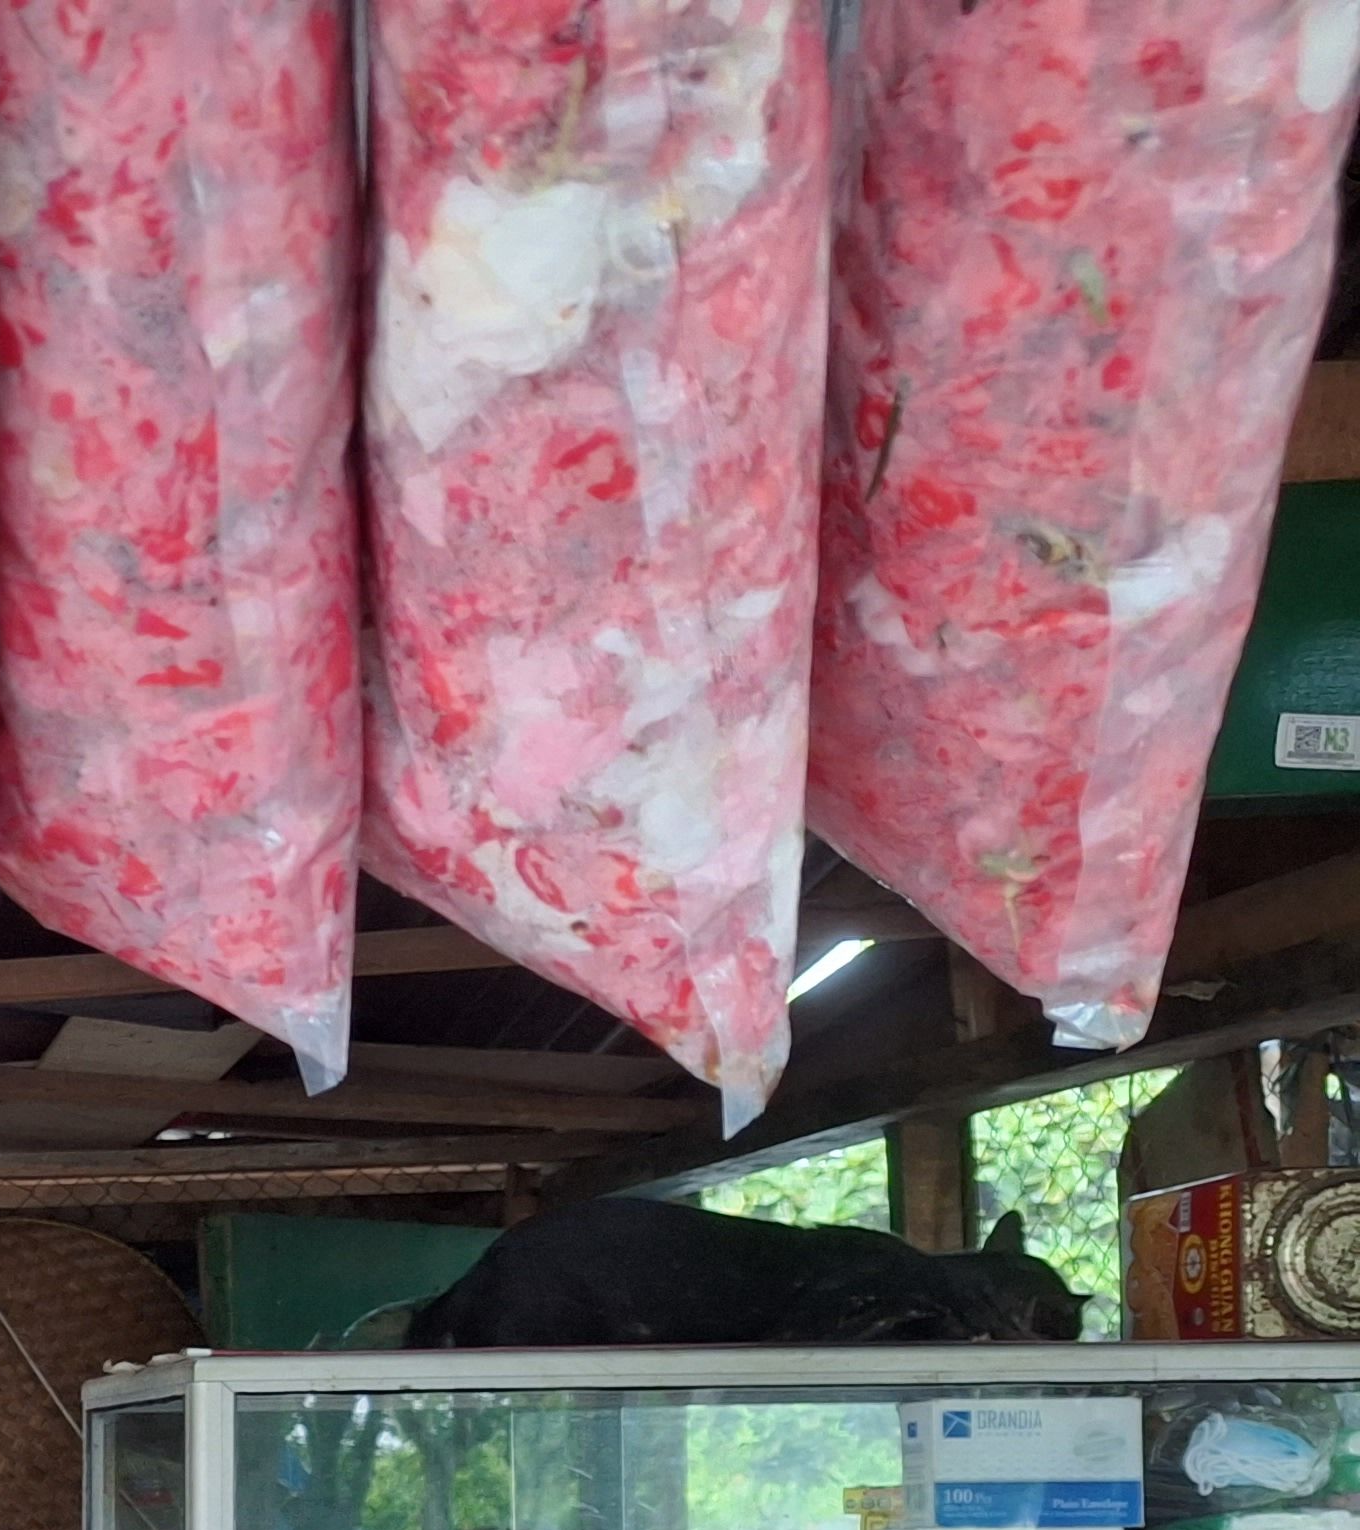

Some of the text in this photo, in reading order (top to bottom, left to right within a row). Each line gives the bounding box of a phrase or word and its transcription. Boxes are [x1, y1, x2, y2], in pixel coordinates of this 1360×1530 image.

[1219, 1184, 1234, 1333] KHONG GUAN
[977, 1410, 1043, 1430] GRANDIA
[944, 1488, 973, 1505] 100
